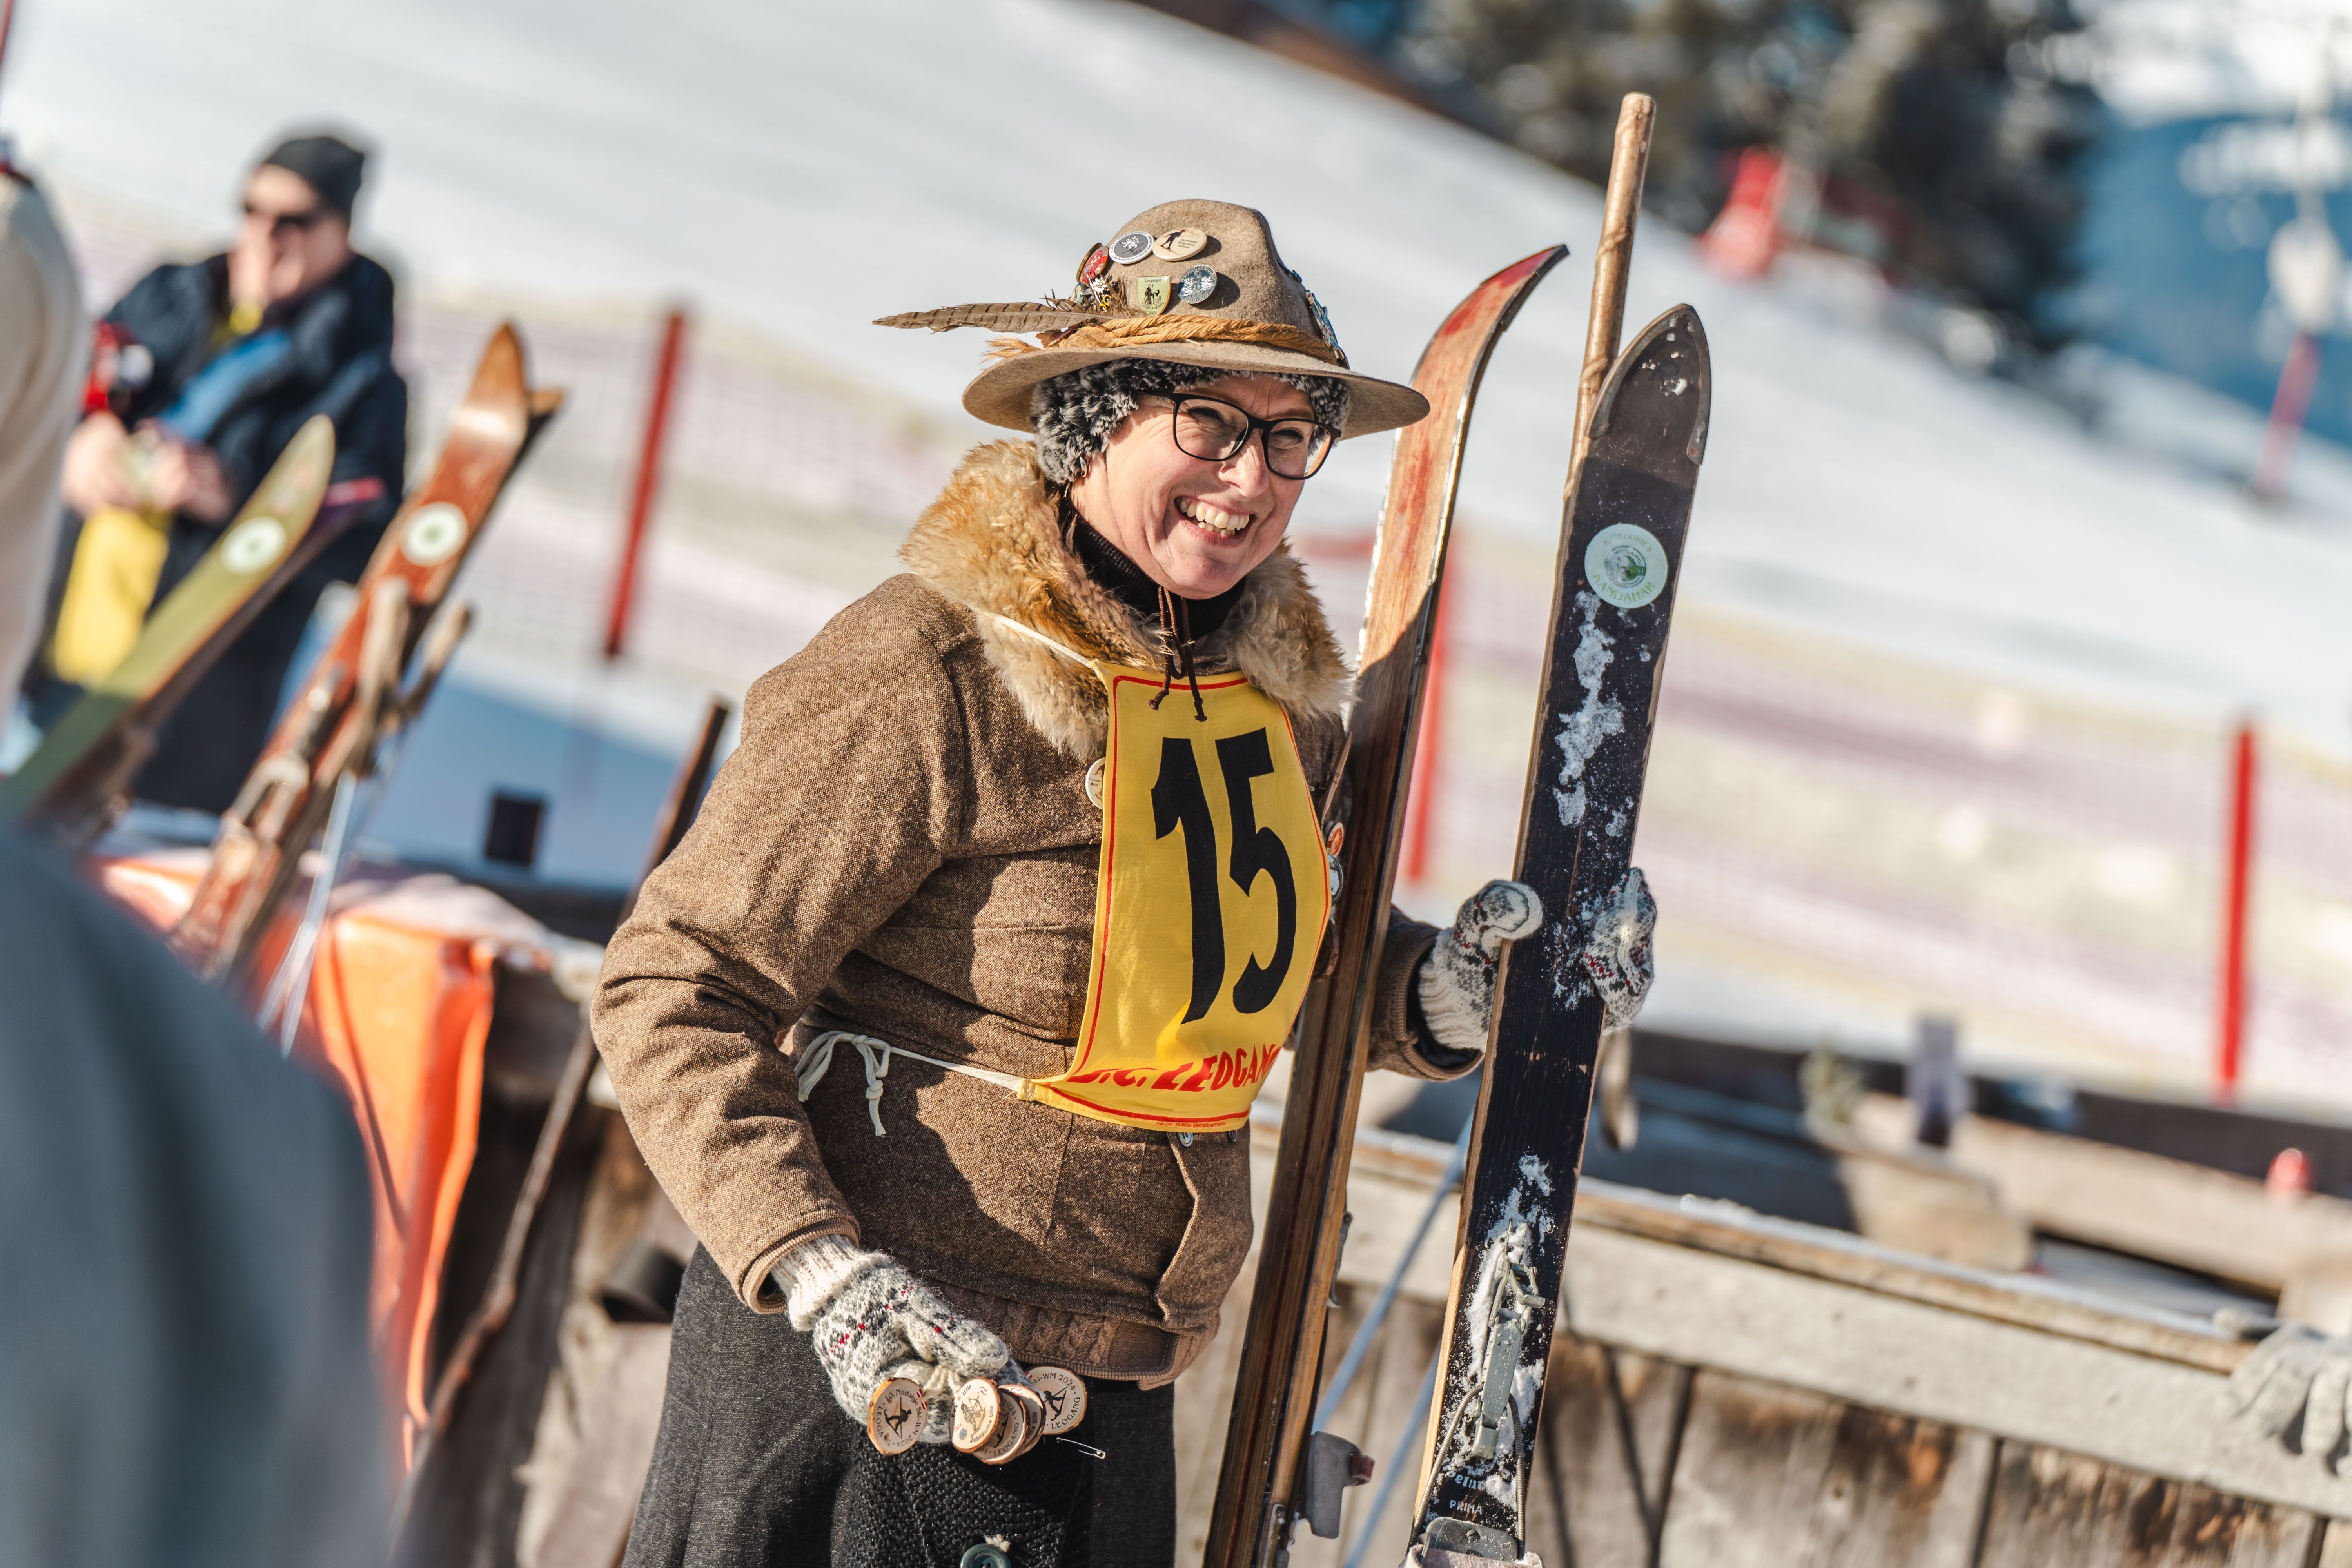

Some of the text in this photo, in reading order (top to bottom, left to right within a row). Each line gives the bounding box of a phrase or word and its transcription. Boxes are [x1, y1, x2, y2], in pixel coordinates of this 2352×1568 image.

[1151, 727, 1296, 1025] 15
[896, 1388, 918, 1406] Nostalgie
[1058, 1374, 1076, 1390] 2024
[876, 1406, 891, 1446] LEOGANG
[912, 1406, 922, 1436] Ski-WM
[1051, 1397, 1080, 1430] LEOGANG
[897, 1434, 913, 1447] 2024
[994, 1422, 1019, 1457] LEOGANG
[1449, 1499, 1483, 1515] PRIMA
